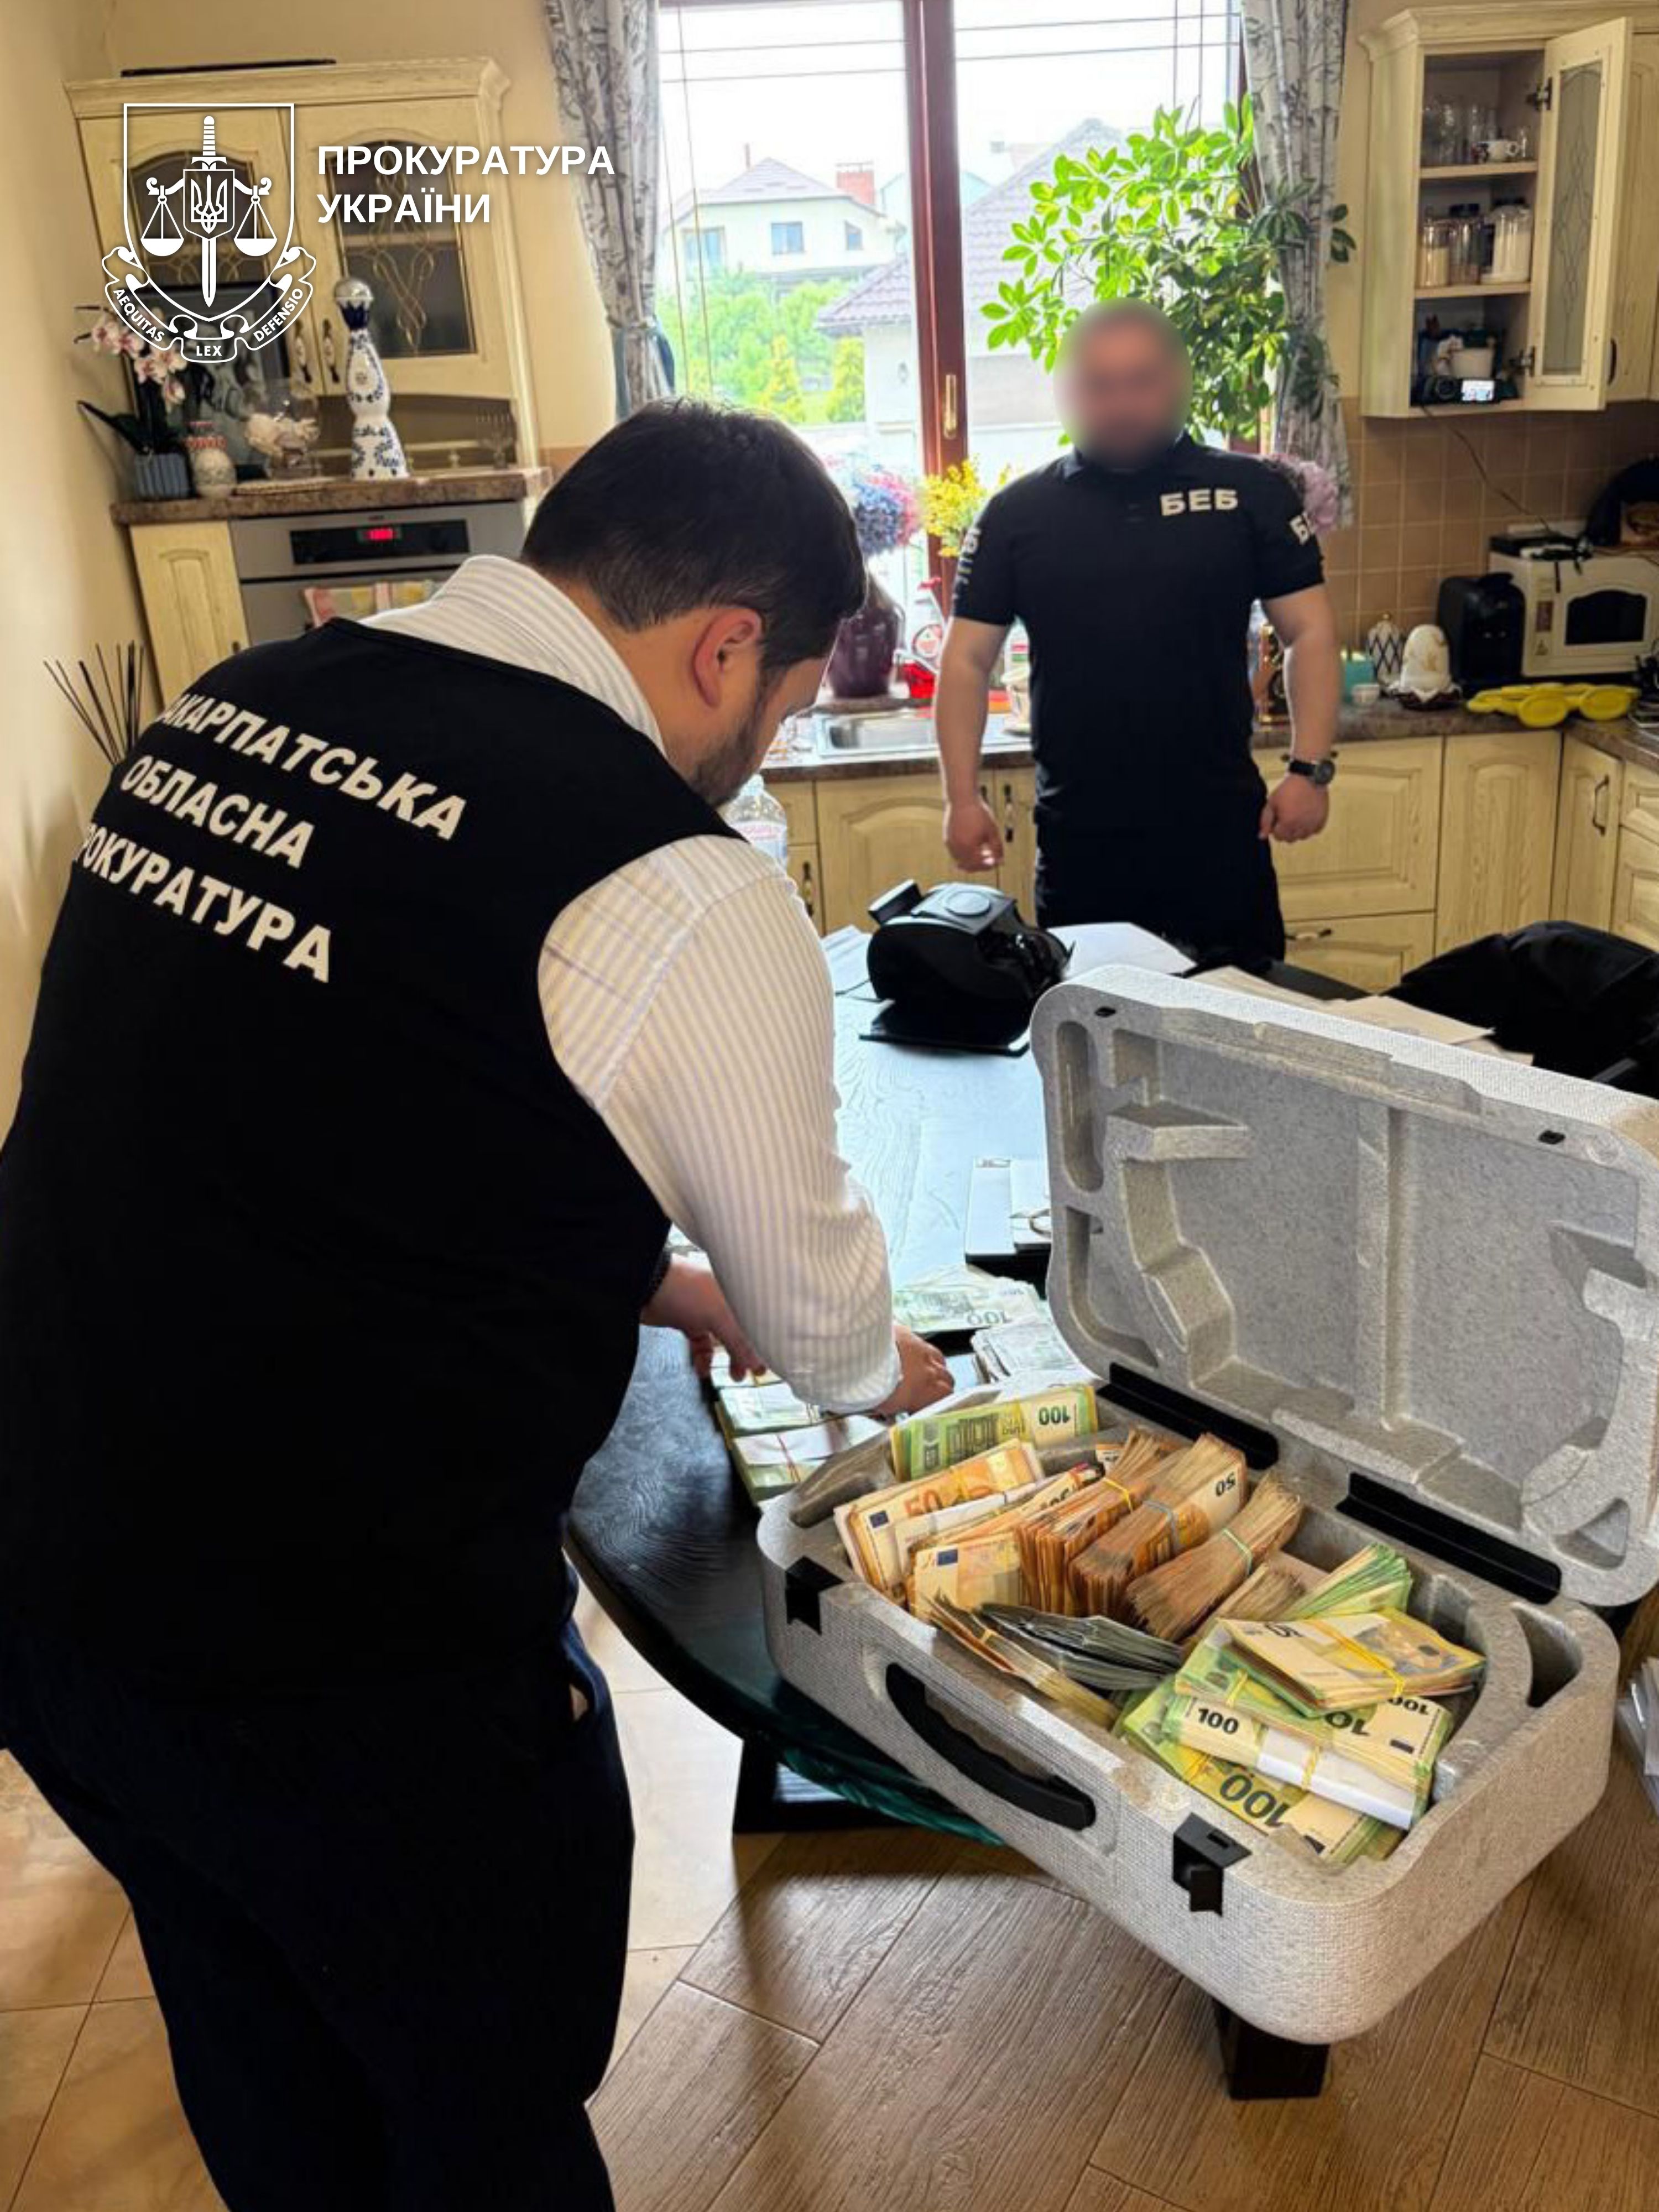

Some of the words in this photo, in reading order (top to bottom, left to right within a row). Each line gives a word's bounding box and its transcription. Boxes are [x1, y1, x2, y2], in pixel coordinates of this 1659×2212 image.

[1160, 489, 1239, 517] БЕБ
[120, 755, 315, 869] ОБЛАСНА
[1038, 1406, 1071, 1426] 100
[1215, 1472, 1236, 1498] 50
[1198, 1708, 1239, 1735] 100
[1219, 1774, 1290, 1827] 100
